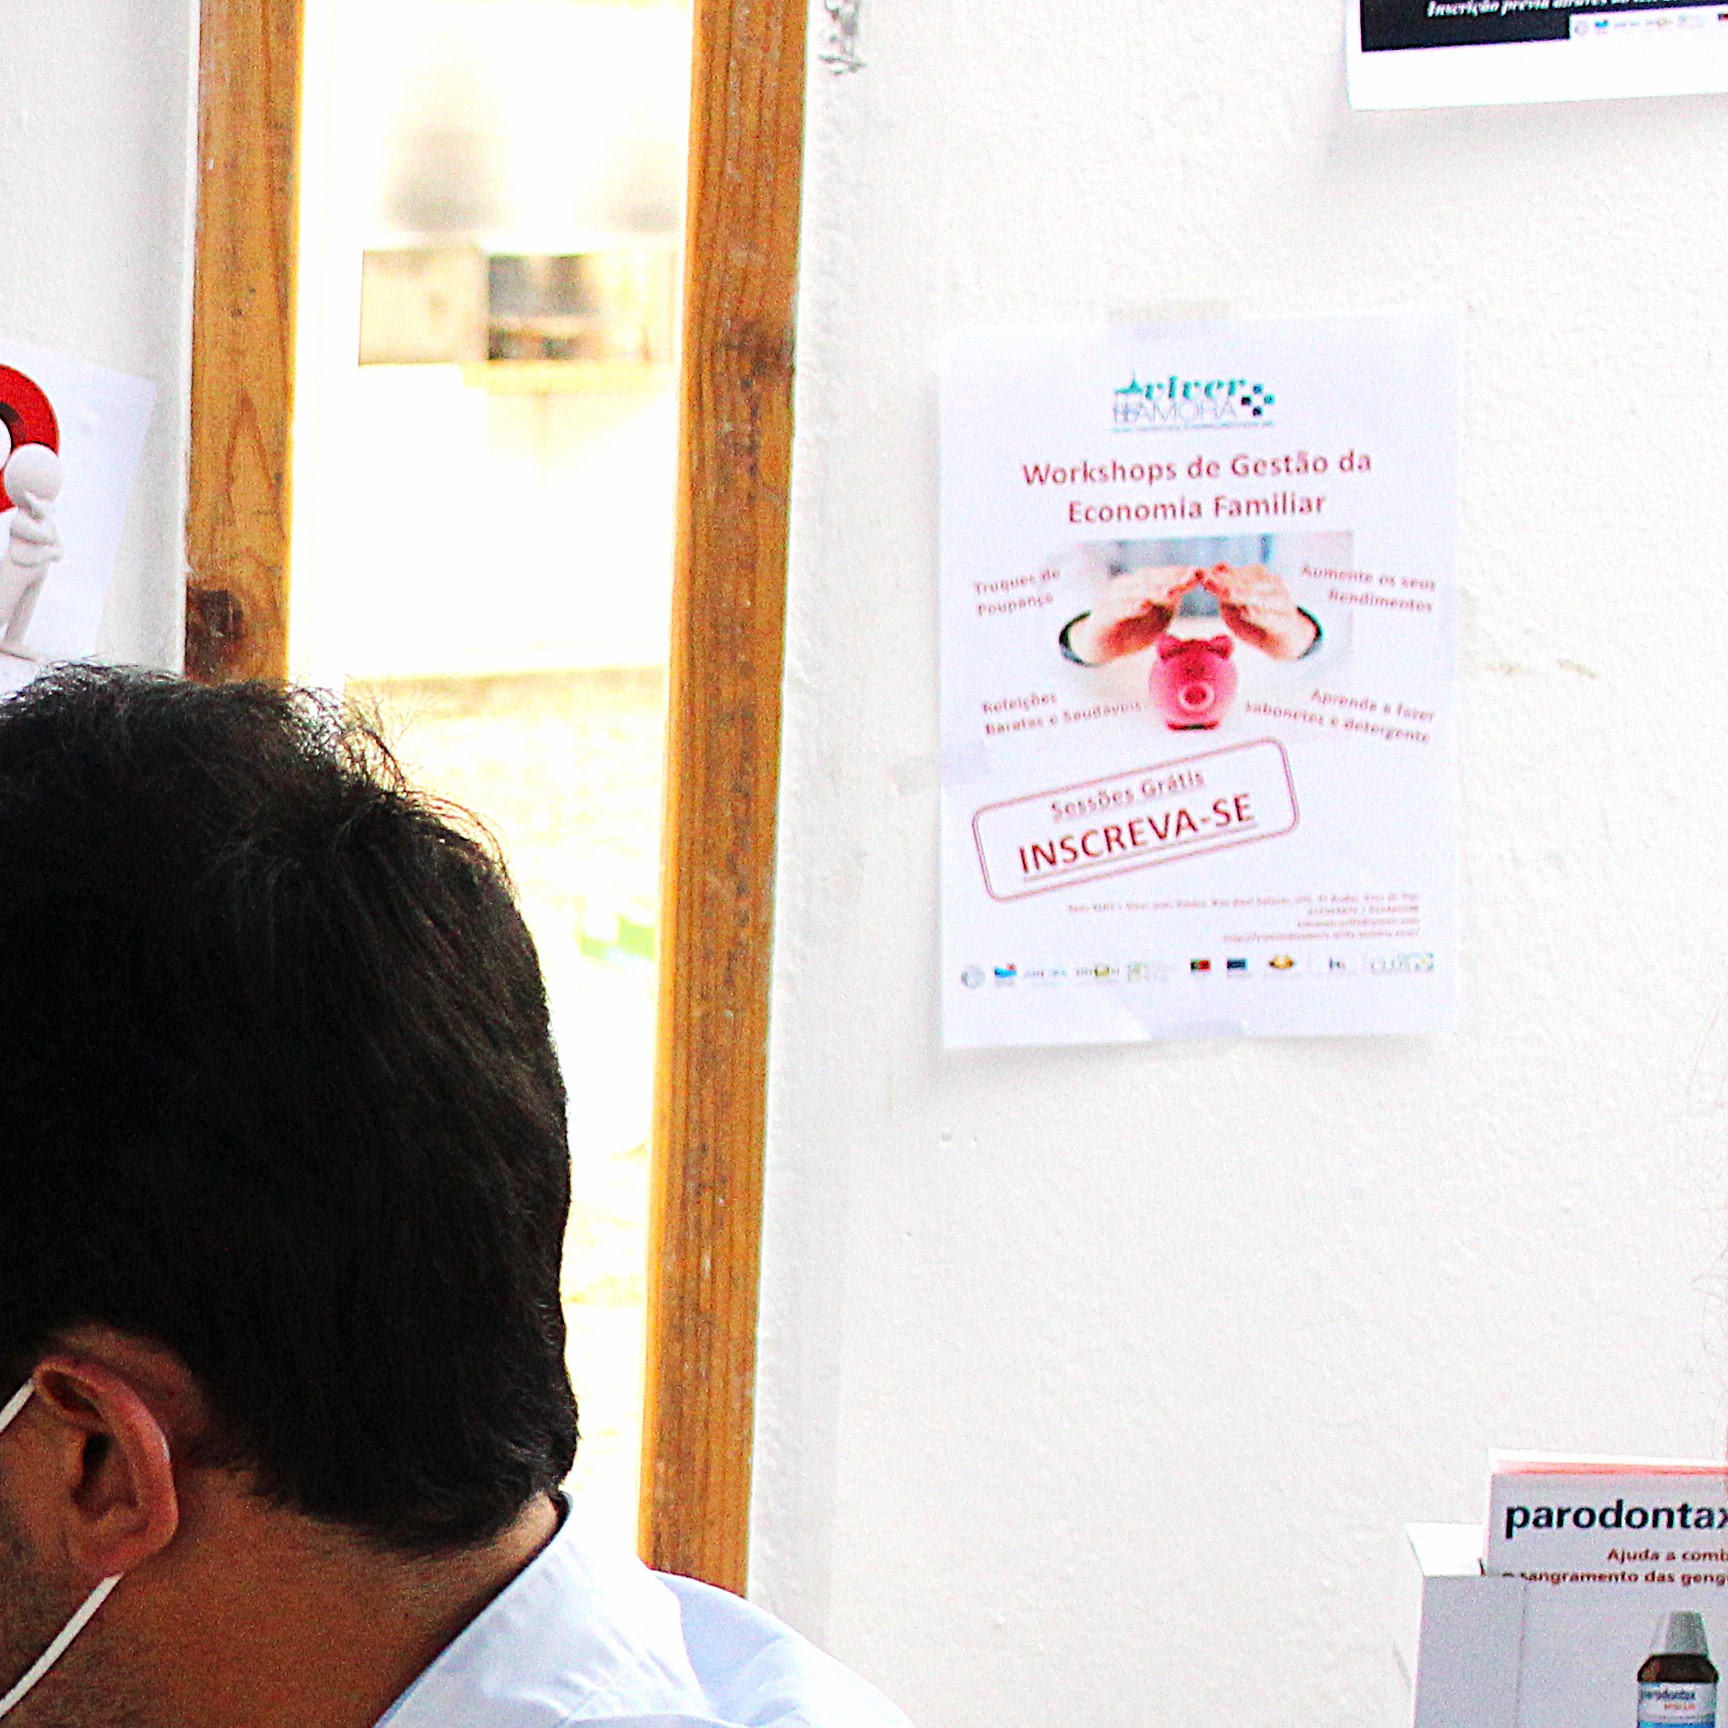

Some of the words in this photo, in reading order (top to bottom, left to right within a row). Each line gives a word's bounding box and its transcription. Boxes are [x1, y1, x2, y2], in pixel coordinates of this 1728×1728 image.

[1127, 398, 1237, 422] AMORA
[1021, 458, 1177, 487] Workshops
[1187, 455, 1219, 477] de
[1231, 451, 1328, 475] Gestão
[1338, 449, 1371, 471] da
[1067, 496, 1202, 522] Economia
[1214, 492, 1326, 517] Familiar
[975, 575, 1035, 595] Truques
[1041, 568, 1061, 580] de
[1301, 562, 1372, 583] Aumente
[1328, 589, 1433, 612] Rendimentos
[983, 692, 1057, 714] Refeições
[1049, 783, 1135, 822] Sessões
[1139, 766, 1206, 801] Grátis
[1017, 791, 1255, 874] INSCREVA-SE
[1607, 1548, 1659, 1564] Ajuda
[1666, 1552, 1676, 1561] a
[1521, 1570, 1638, 1585] sangramento
[1645, 1571, 1674, 1582] das
